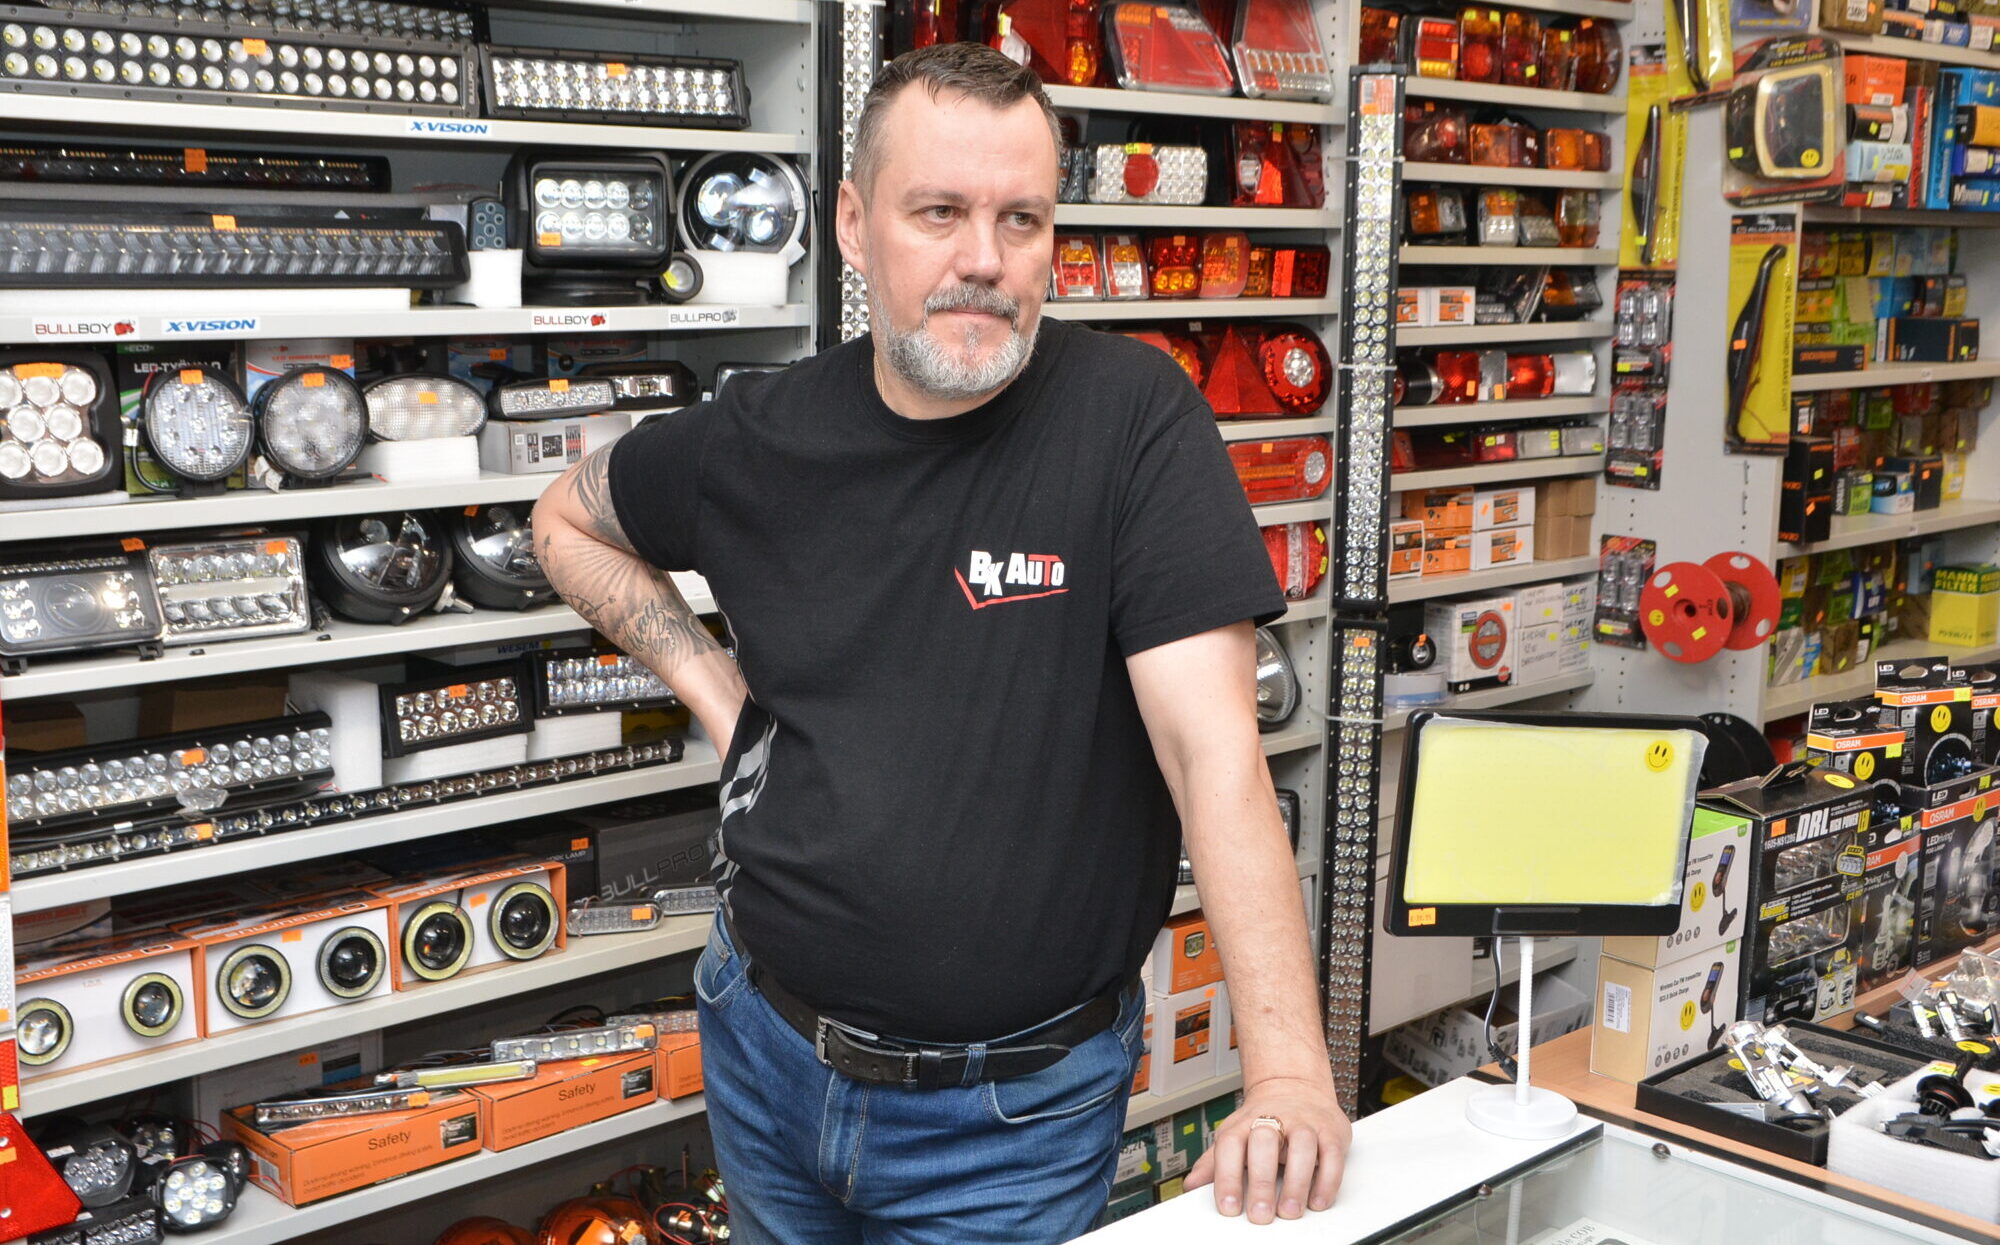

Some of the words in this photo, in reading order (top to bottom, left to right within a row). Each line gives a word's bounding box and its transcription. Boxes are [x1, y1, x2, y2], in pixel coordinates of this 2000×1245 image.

[410, 121, 488, 134] X-VISION
[533, 315, 590, 326] BULLBOY
[670, 312, 722, 323] BULLPRO
[35, 323, 112, 335] BULLBOY
[166, 320, 256, 332] X-VISION
[1902, 694, 1927, 704] OSRAM
[1974, 698, 1997, 706] OSRAM
[1836, 740, 1862, 749] OSRAM
[1932, 789, 1948, 802] LED
[1930, 808, 1955, 824] OSRAM
[1796, 808, 1830, 842] DRL
[1842, 812, 1858, 829] POWER
[1866, 854, 1882, 866] RAM
[558, 1082, 596, 1102] Safety
[368, 1130, 412, 1151] Safety
